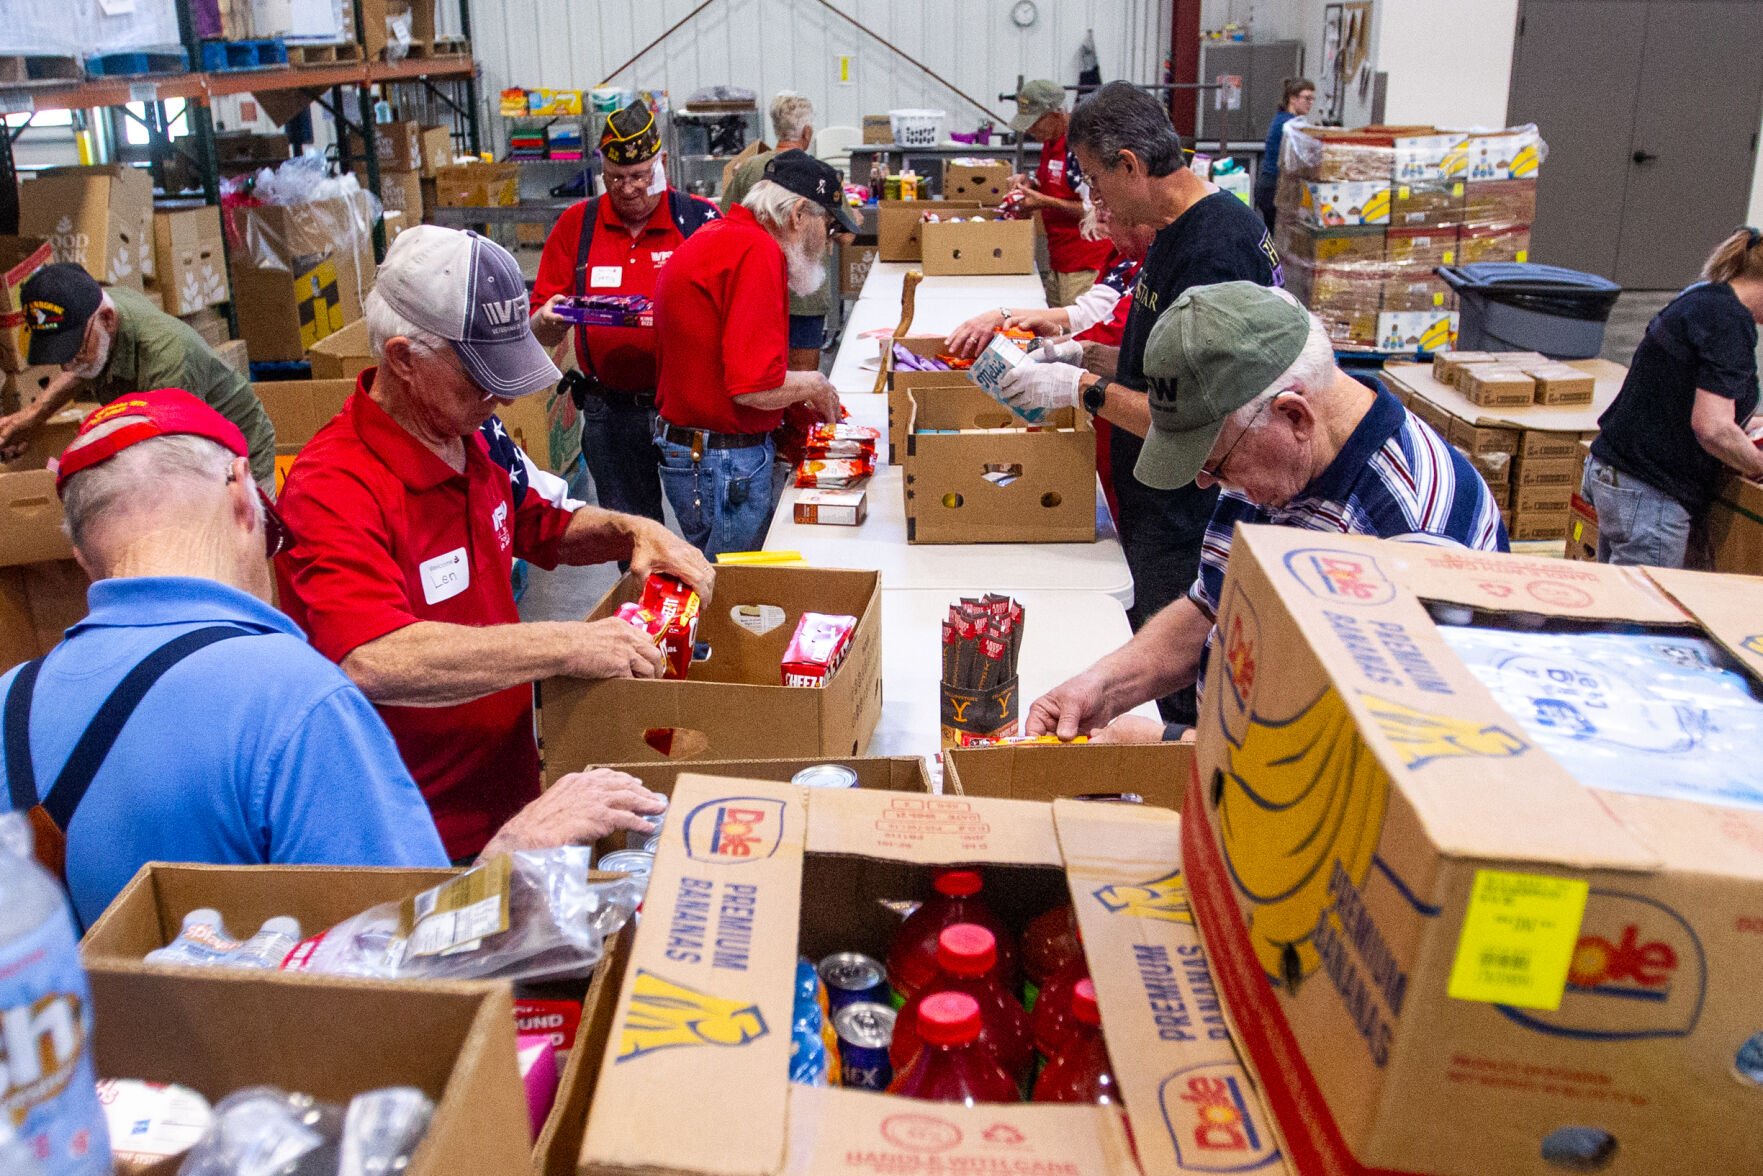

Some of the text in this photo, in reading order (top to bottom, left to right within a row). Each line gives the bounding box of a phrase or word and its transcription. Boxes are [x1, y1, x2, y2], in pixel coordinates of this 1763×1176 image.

[42, 234, 89, 248] OOD
[650, 251, 673, 262] VF
[850, 263, 867, 273] FO
[482, 295, 526, 326] VF
[1146, 377, 1178, 402] W
[430, 571, 458, 589] Len
[1321, 557, 1380, 600] Dole
[1322, 609, 1405, 688] BANANAS
[1368, 619, 1457, 695] PREMIUM
[719, 807, 765, 857] Dole
[665, 876, 714, 965] BANANAS
[712, 882, 758, 971] PREMIUM
[1566, 923, 1679, 987] ole
[1133, 943, 1197, 1042] PREMIUM
[517, 1013, 564, 1030] UND
[1181, 1076, 1249, 1151] Dole
